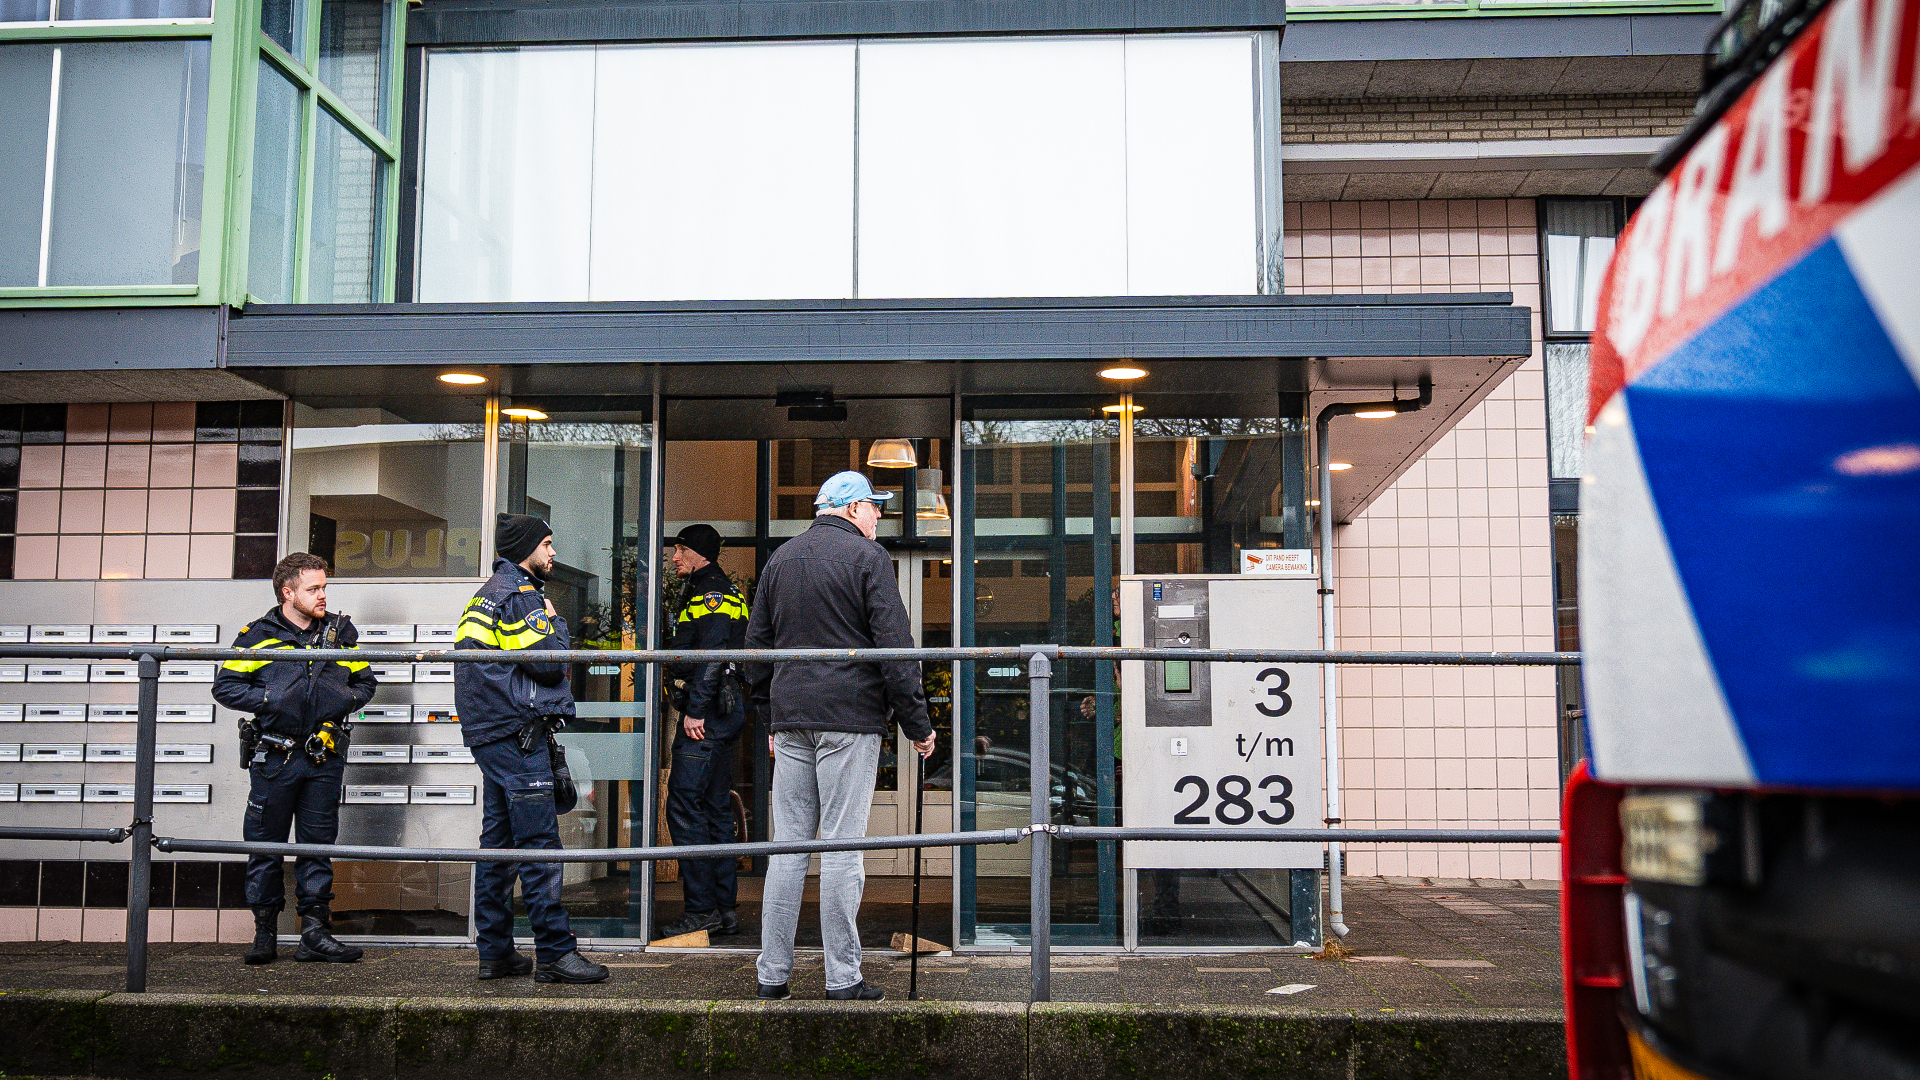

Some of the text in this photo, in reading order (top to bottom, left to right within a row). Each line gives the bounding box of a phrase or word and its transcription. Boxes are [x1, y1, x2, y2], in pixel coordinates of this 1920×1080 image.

[1605, 0, 1920, 358] BRAN
[1265, 563, 1308, 571] CAMERA BEWAKING
[1273, 554, 1285, 562] PAND
[1255, 667, 1293, 718] 3
[1235, 732, 1294, 762] t/m
[1173, 774, 1295, 825] 283
